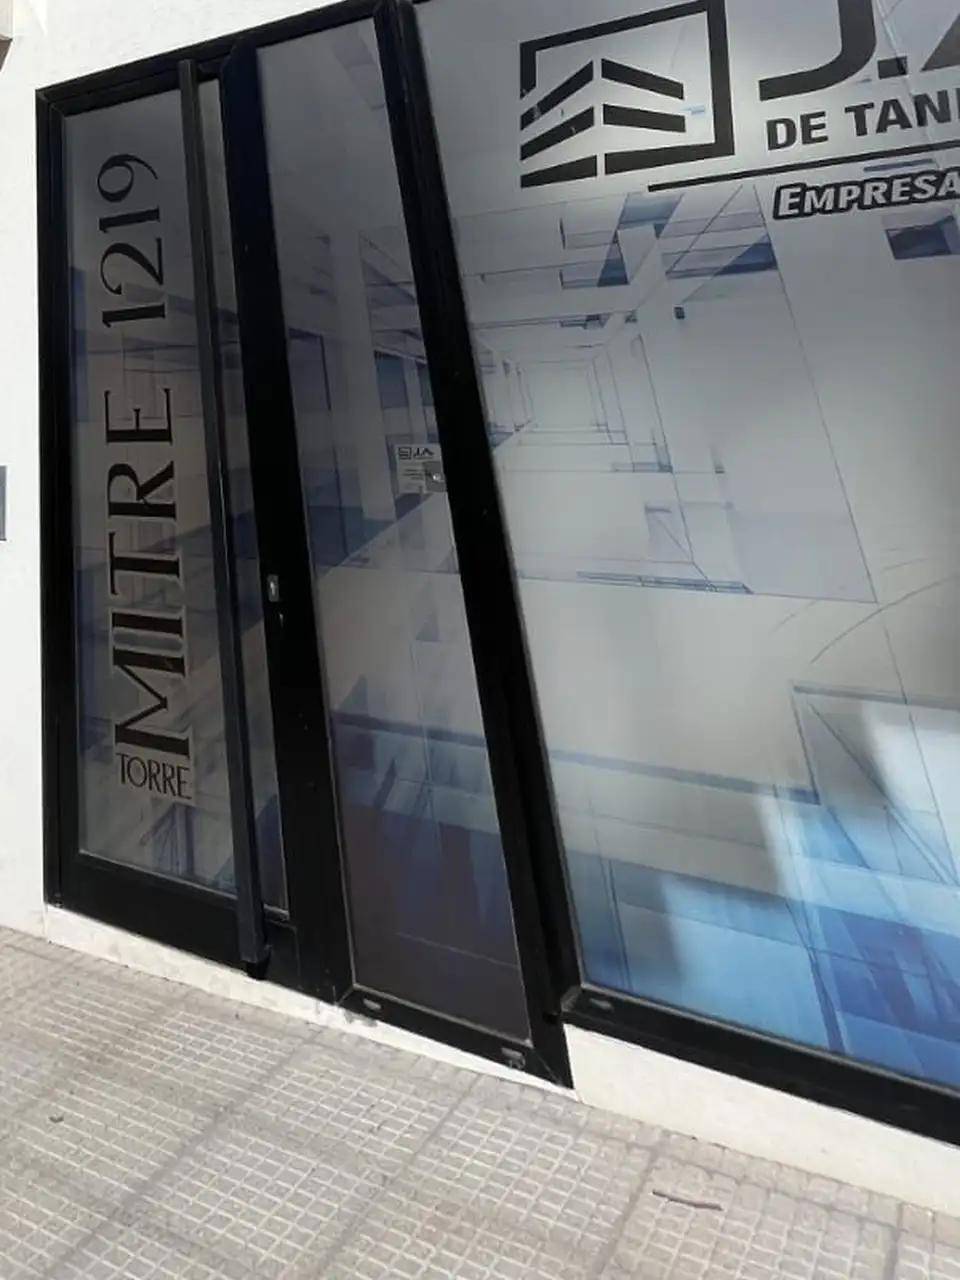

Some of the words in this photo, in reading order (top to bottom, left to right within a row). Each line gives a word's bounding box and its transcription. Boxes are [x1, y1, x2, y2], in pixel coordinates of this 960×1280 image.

[766, 111, 829, 152] DE
[843, 87, 960, 137] TAN
[773, 167, 960, 219] EMPRESA
[97, 153, 166, 328] 1219
[104, 387, 191, 760] MITRE
[115, 752, 193, 800] TORRE
